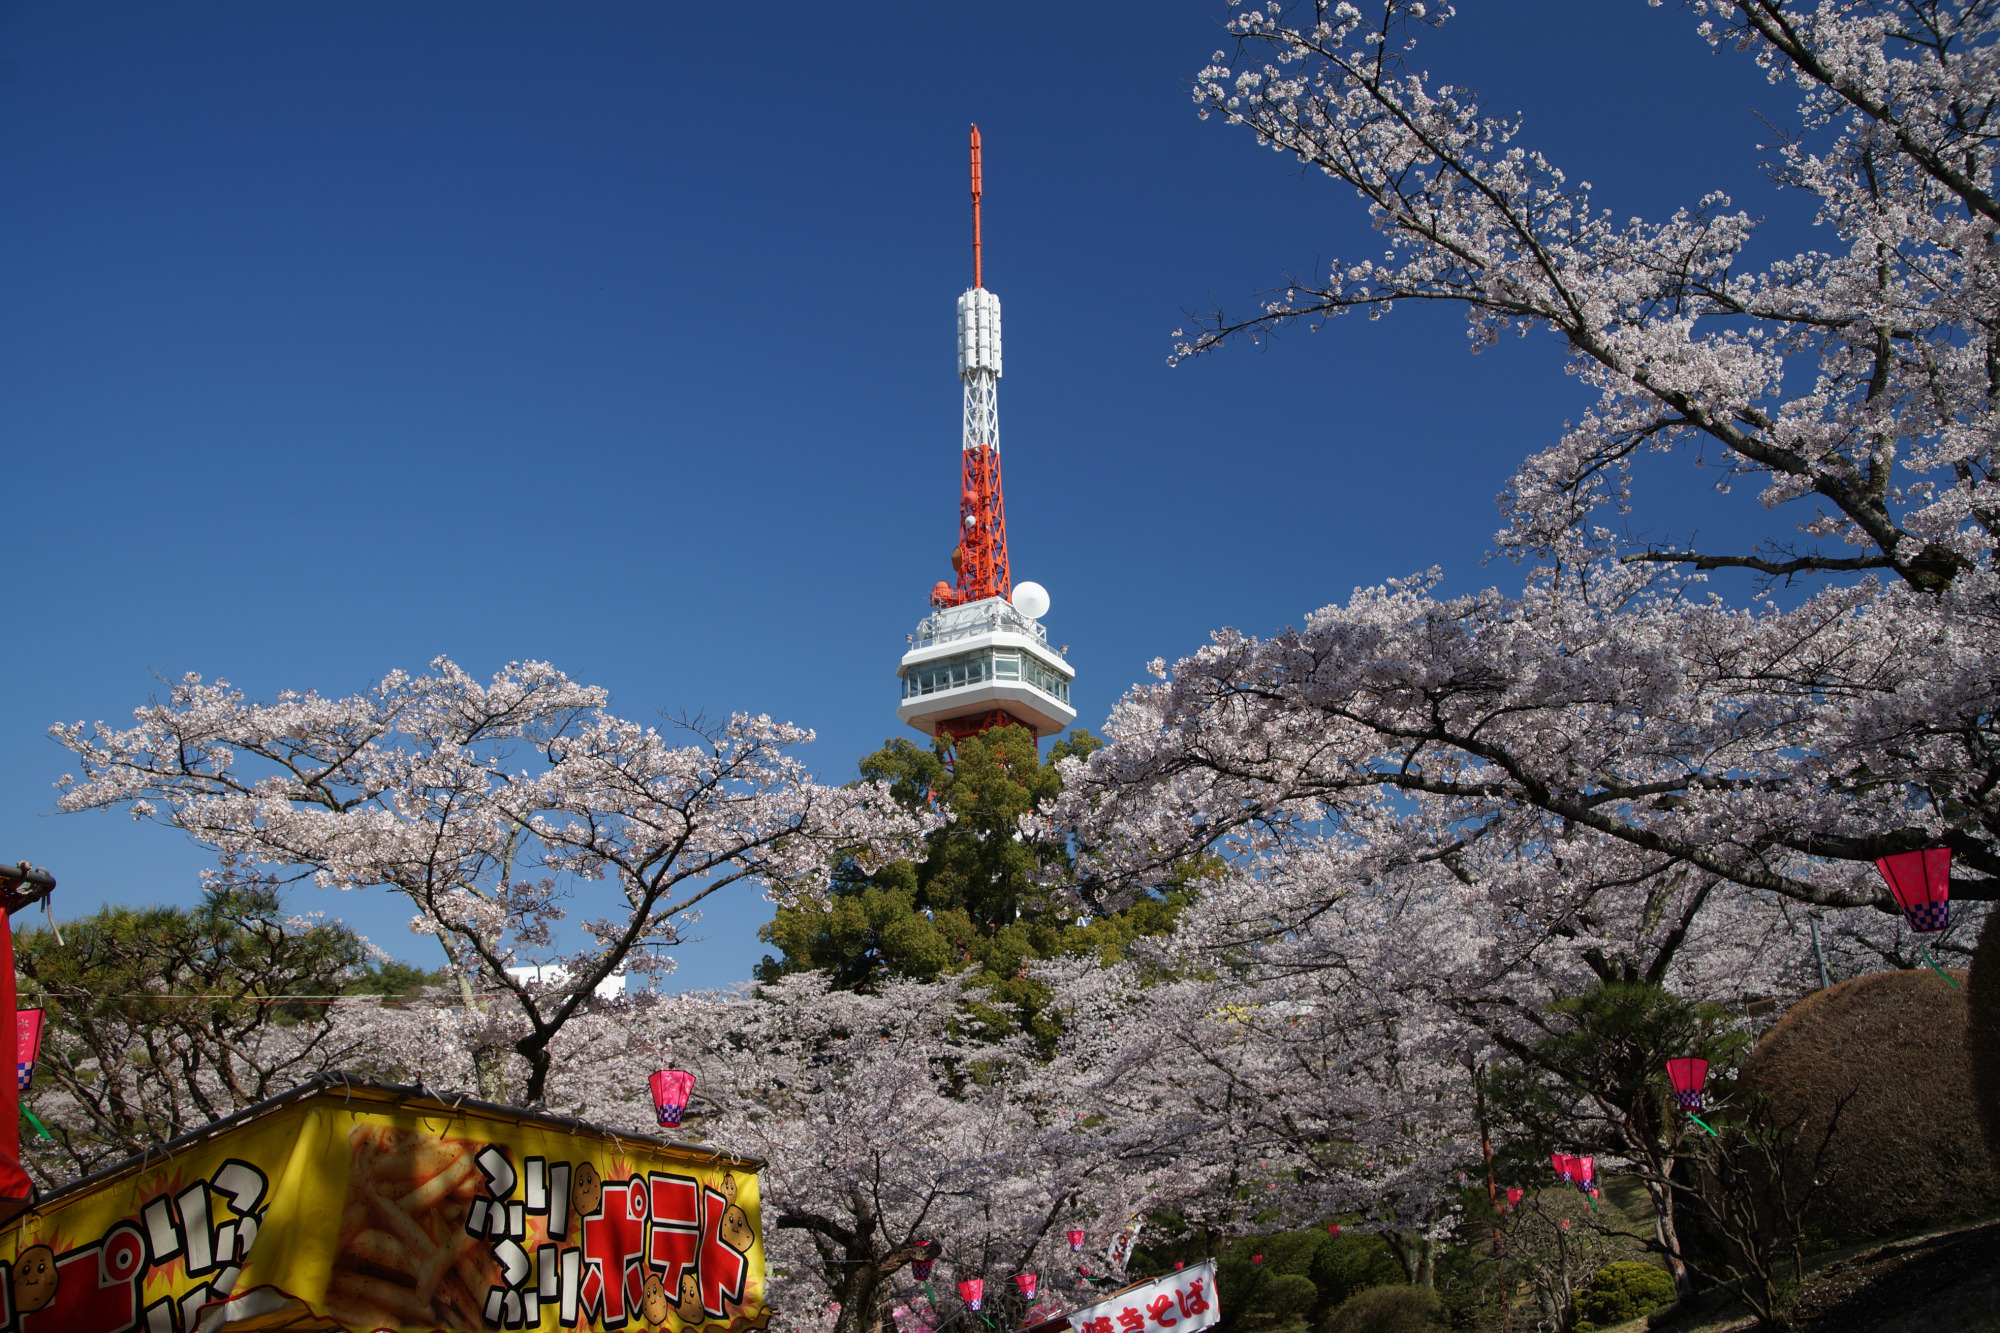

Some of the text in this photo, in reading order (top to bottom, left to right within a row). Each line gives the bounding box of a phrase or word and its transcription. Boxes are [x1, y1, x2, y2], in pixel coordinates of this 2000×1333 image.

[467, 1144, 571, 1241] ふり
[483, 1238, 580, 1329] ふり
[581, 1171, 747, 1331] ポテト
